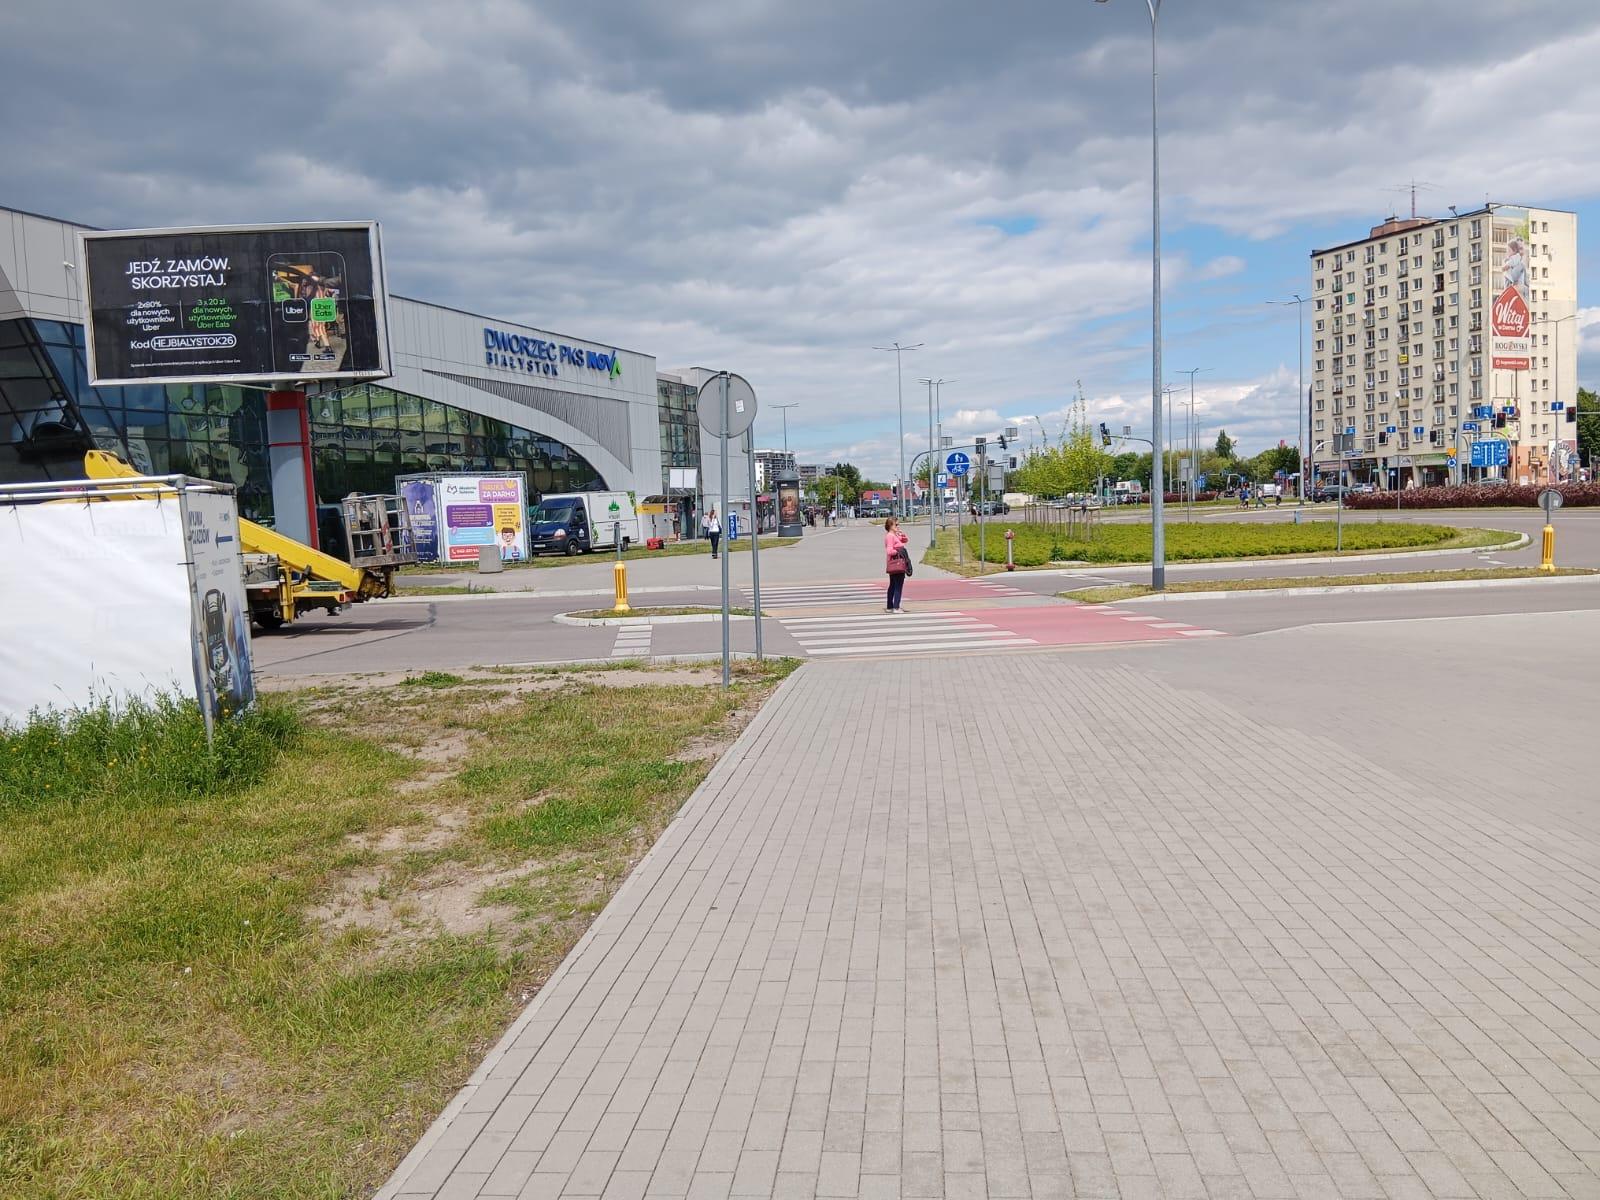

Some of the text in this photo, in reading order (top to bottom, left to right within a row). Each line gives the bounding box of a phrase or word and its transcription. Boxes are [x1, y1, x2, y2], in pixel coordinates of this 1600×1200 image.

[125, 256, 231, 274] JEDŹ. ZAMÓW.
[131, 274, 227, 289] SKORZYSTAJ.
[142, 308, 170, 317] nowych
[204, 306, 233, 315] nowych
[285, 306, 304, 314] Uber
[1495, 296, 1525, 332] Witaj
[126, 315, 175, 325] użytkowników
[188, 313, 237, 323] użytkowników
[130, 336, 234, 349] Kod HEJBIALYSTOK26
[484, 328, 621, 380] DWORZEC PKS NOVA
